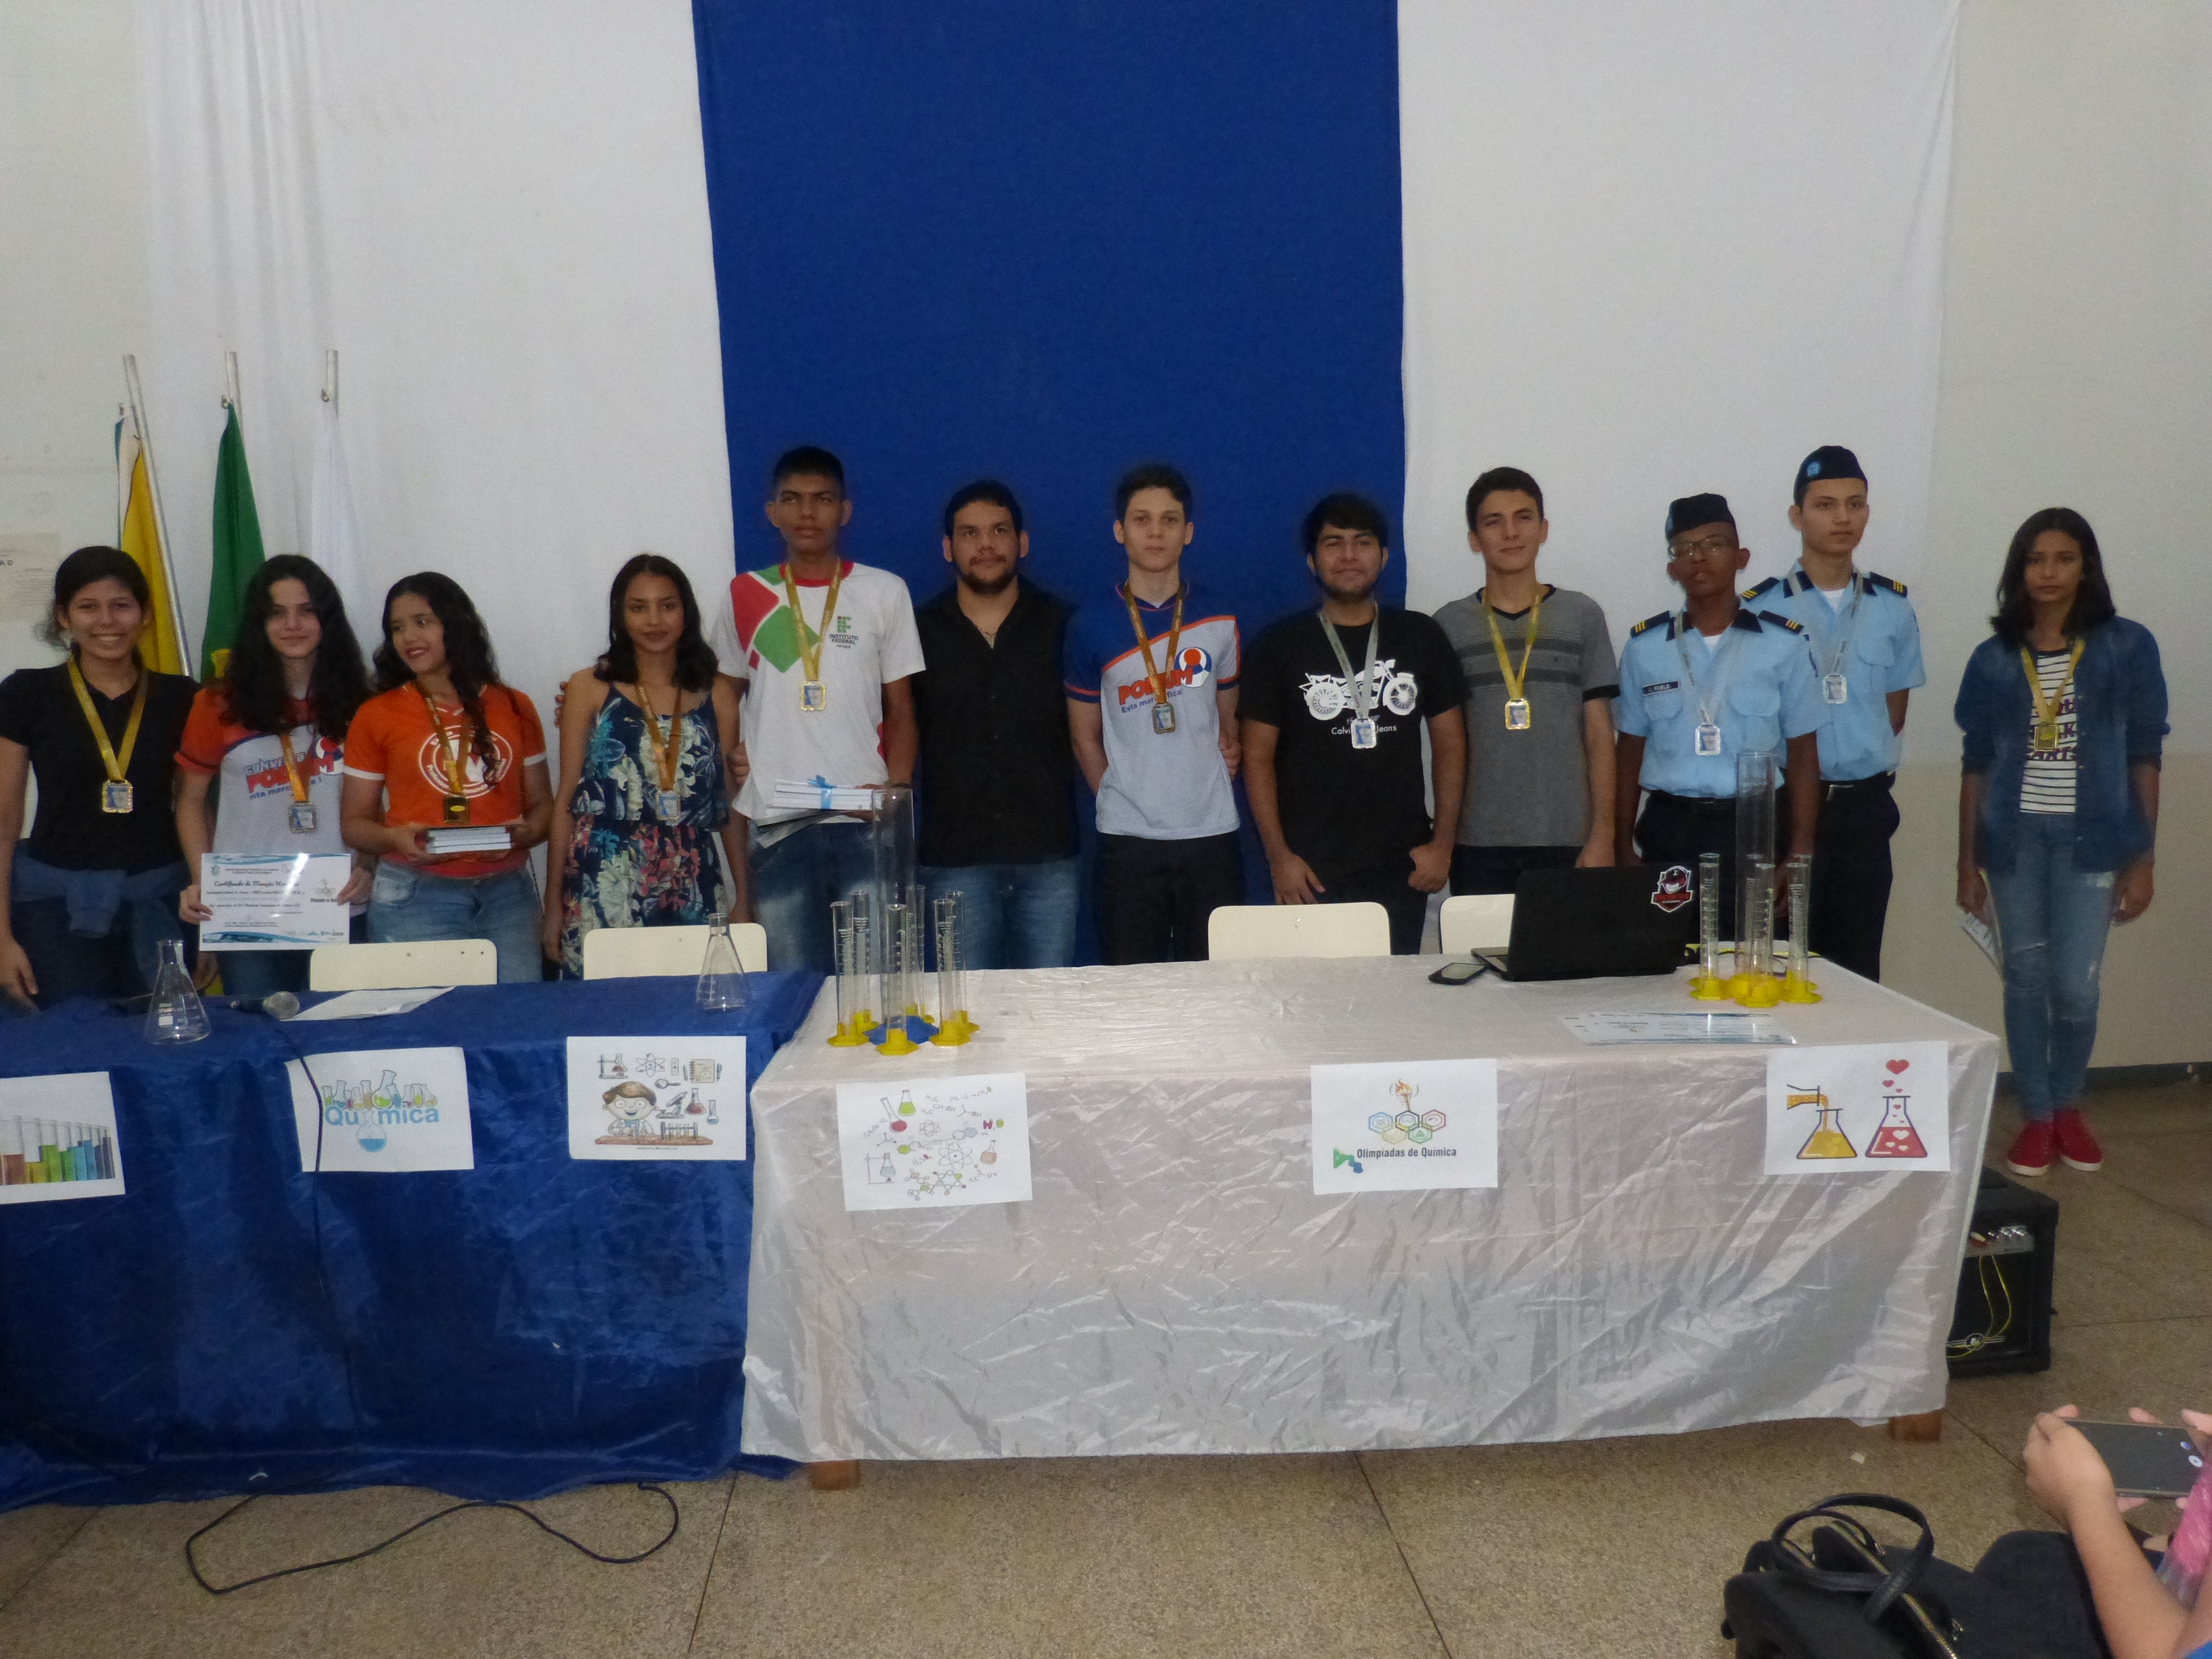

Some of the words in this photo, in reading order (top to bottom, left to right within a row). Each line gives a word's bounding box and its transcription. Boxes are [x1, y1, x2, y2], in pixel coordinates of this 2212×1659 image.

[1118, 666, 1193, 705] PODUM
[1121, 704, 1138, 713] Esta
[1140, 697, 1156, 707] mar
[1331, 727, 1351, 735] Calvi
[1375, 725, 1397, 734] Jeans
[325, 1105, 440, 1126] Qumica
[1407, 1148, 1419, 1157] de
[1421, 1147, 1457, 1157] Química
